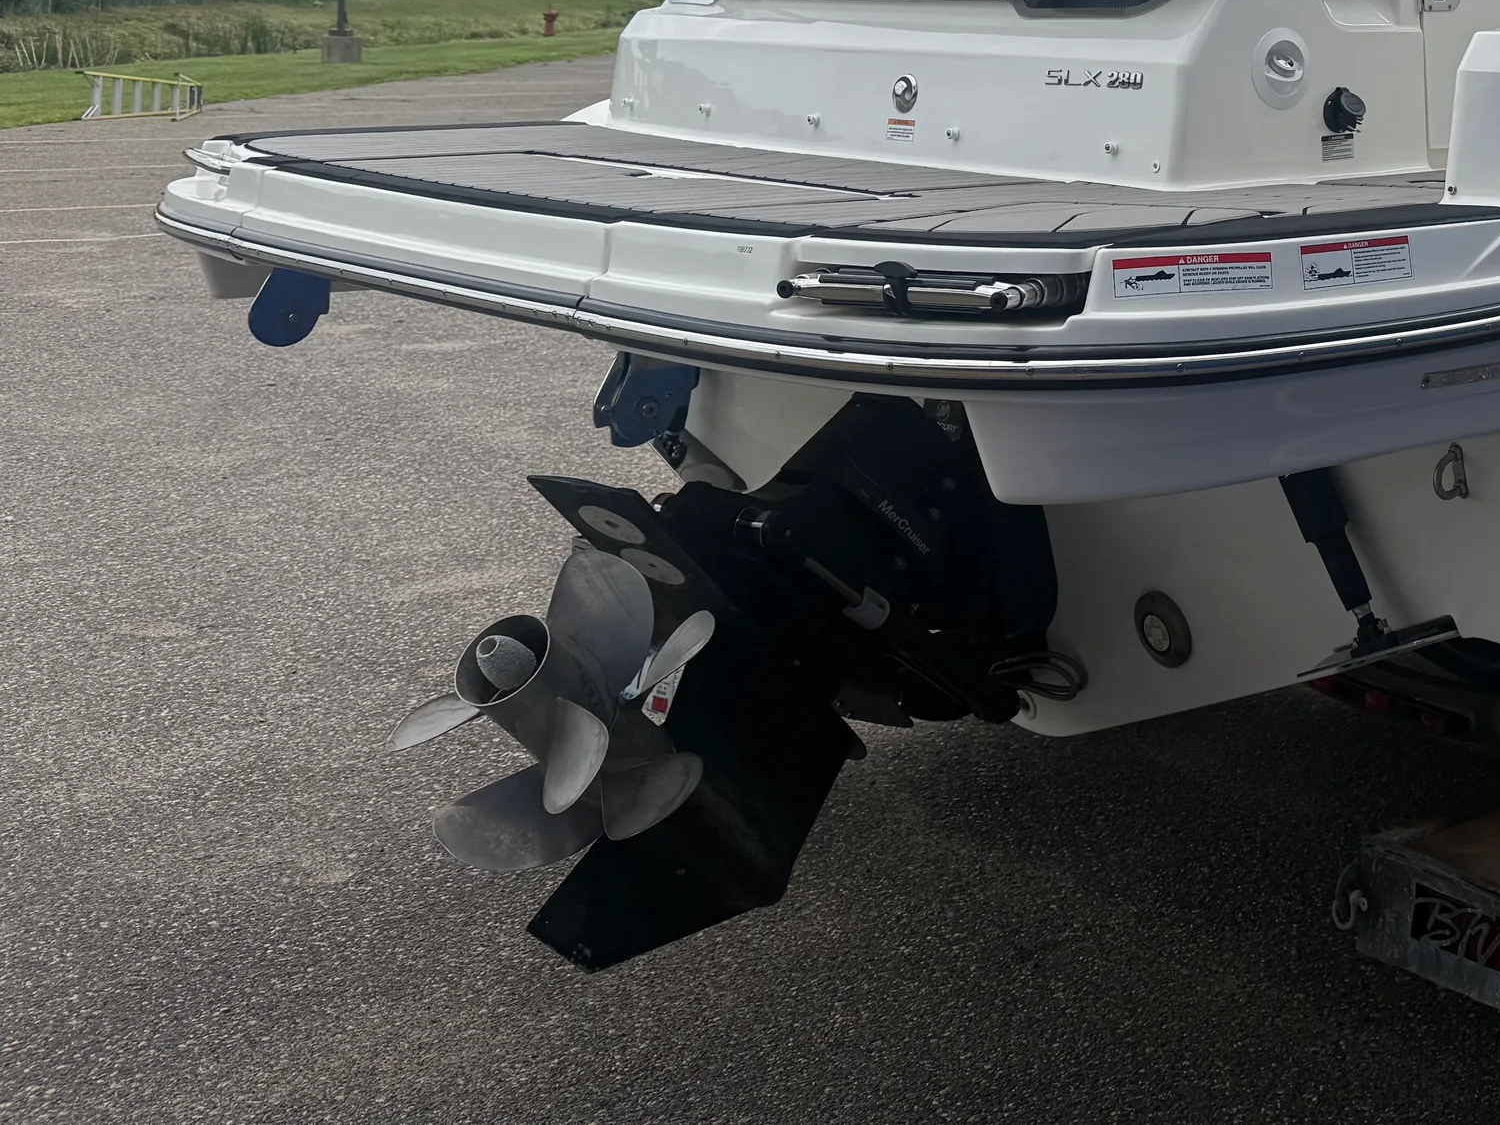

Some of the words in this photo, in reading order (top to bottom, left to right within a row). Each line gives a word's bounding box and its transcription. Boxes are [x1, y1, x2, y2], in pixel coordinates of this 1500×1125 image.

[1044, 69, 1103, 88] SLX
[1106, 71, 1144, 90] 280
[1186, 255, 1220, 264] DANGER
[877, 499, 931, 555] MerCruiser
